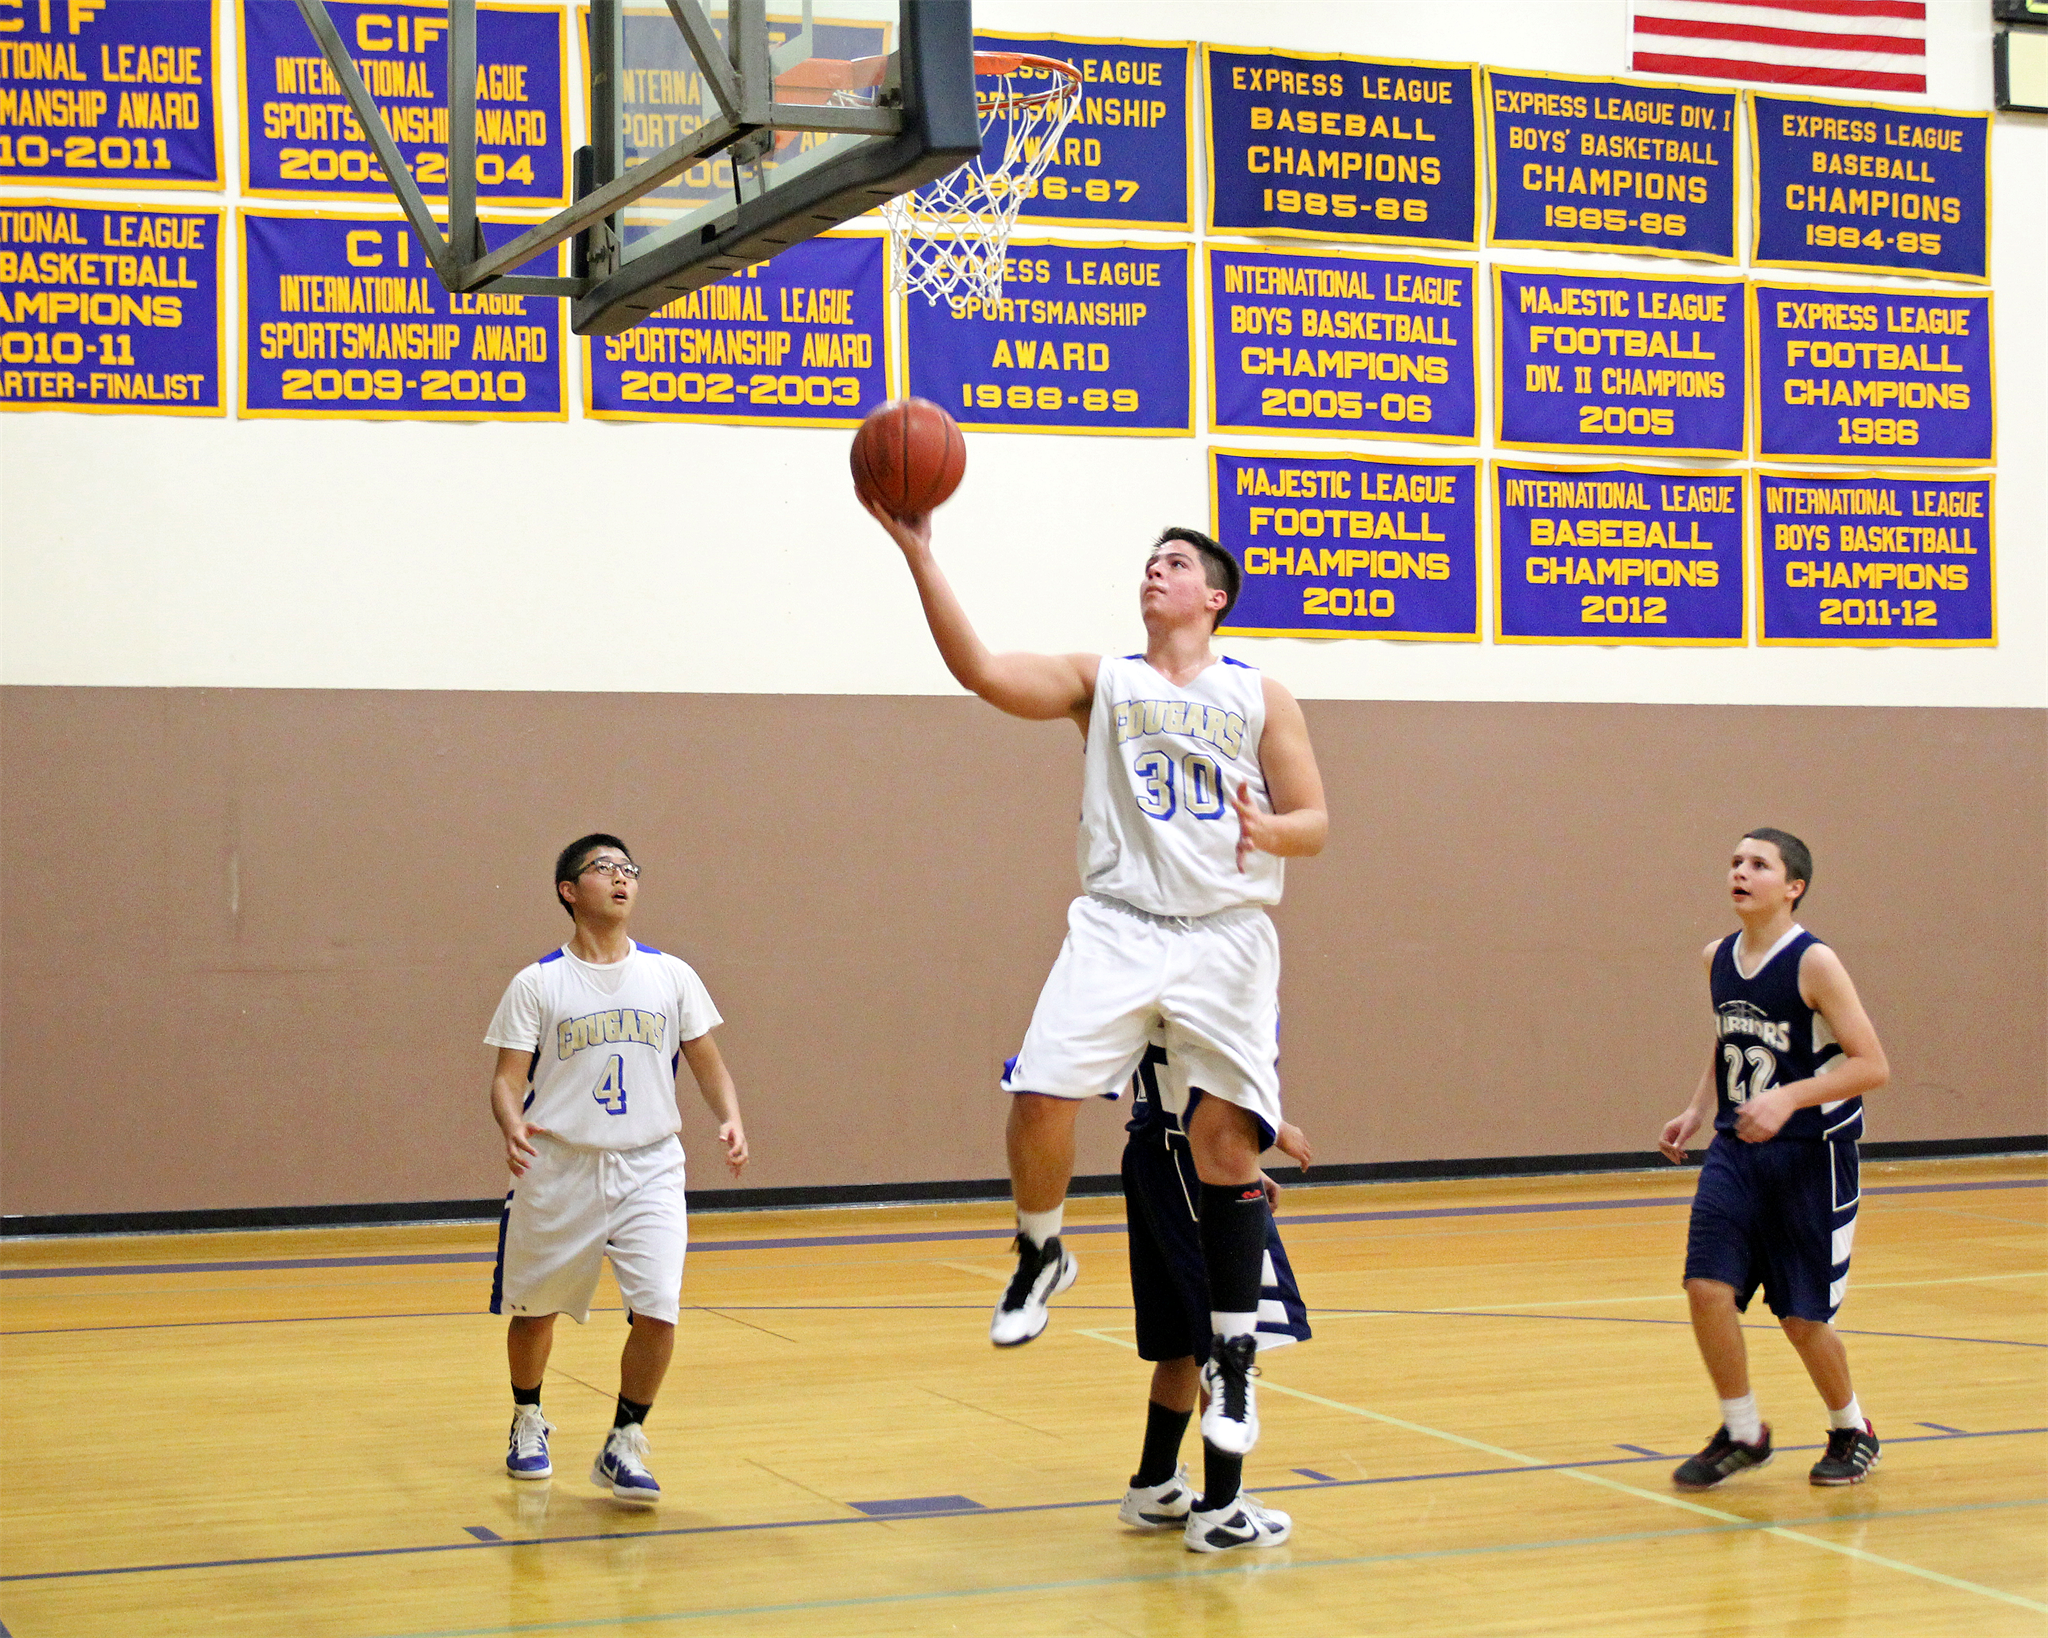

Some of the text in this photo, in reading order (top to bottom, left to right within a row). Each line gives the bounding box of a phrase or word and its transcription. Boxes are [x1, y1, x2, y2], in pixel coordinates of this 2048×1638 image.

[356, 13, 448, 53] CIF
[102, 45, 202, 84] LEAGUE
[475, 63, 528, 101] AGUE
[1233, 67, 1452, 104] EXPRESS LEAGUE
[118, 93, 199, 129] AWARD
[475, 108, 547, 146] AWARD
[1251, 107, 1435, 141] BASEBALL
[1495, 90, 1587, 118] EXPRESS
[1595, 98, 1674, 125] LEAGUE
[1681, 105, 1716, 130] DIV.
[1581, 134, 1718, 165] BASKETBALL
[1783, 115, 1962, 152] EXPRESS LEAGUE
[279, 147, 535, 185] 200-204
[1248, 146, 1441, 185] CHAMPIONS
[1813, 152, 1935, 183] BASEBALL
[1523, 164, 1707, 203] CHAMPIONS
[1264, 189, 1427, 222] 1985-86
[1546, 205, 1686, 236] 1985-86
[1786, 184, 1960, 223] CHAMPIONS
[104, 216, 205, 249] LEAGUE
[1807, 224, 1941, 255] 1984-85
[1067, 261, 1160, 286] LEAGUE
[1225, 265, 1462, 306] INTERNATIONAL LEAGUE
[281, 275, 434, 314] INTERNATIONAL
[781, 288, 853, 324] LEAGUE
[951, 296, 1147, 327] SPORTSMANSHIP
[1521, 287, 1726, 322] MAJESTIC LEAGUE
[1231, 306, 1457, 345] BOYS BASKETBALL
[1777, 302, 1969, 335] EXPRESS LEAGUE
[261, 323, 547, 362] SPORTSMANSHIP AWARD
[605, 327, 872, 368] SPORTSMANSHIP AWARD
[993, 340, 1109, 371] AWARD
[1530, 326, 1715, 360] FOOTBALL
[1788, 341, 1962, 372] FOOTBALL
[1242, 347, 1448, 383] CHAMPIONS
[1526, 365, 1724, 398] DIV. II CHAMPIONS
[282, 370, 526, 401] 2009-2010
[621, 371, 860, 406] 2002-2003
[963, 384, 1138, 411] 1988-89
[1785, 379, 1970, 409] CHAMPIONS
[1262, 389, 1431, 422] 2005-06
[1580, 406, 1673, 435] 2005
[1838, 418, 1918, 445] 1986
[1237, 468, 1456, 503] MAJESTIC LEAGUE
[1507, 480, 1735, 513] INTERNATIONAL LEAGUE
[1767, 487, 1983, 517] INTERNATIONAL LEAGUE
[1250, 507, 1445, 541] FOOTBALL
[1531, 519, 1712, 549] BASEBALL
[1775, 525, 1977, 554] BOYS BASKETBALL
[1245, 547, 1449, 580] CHAMPIONS
[1526, 557, 1718, 587] CHAMPIONS
[1786, 561, 1968, 590] CHAMPIONS
[1304, 588, 1394, 617] 2010
[1582, 596, 1667, 623] 2012
[1820, 599, 1937, 626] 2011-12
[1113, 699, 1246, 761] COUGARS
[1134, 750, 1226, 821] 30
[557, 1009, 667, 1061] COUGARS
[592, 1054, 627, 1115] 4
[1723, 1044, 1780, 1103] 22
